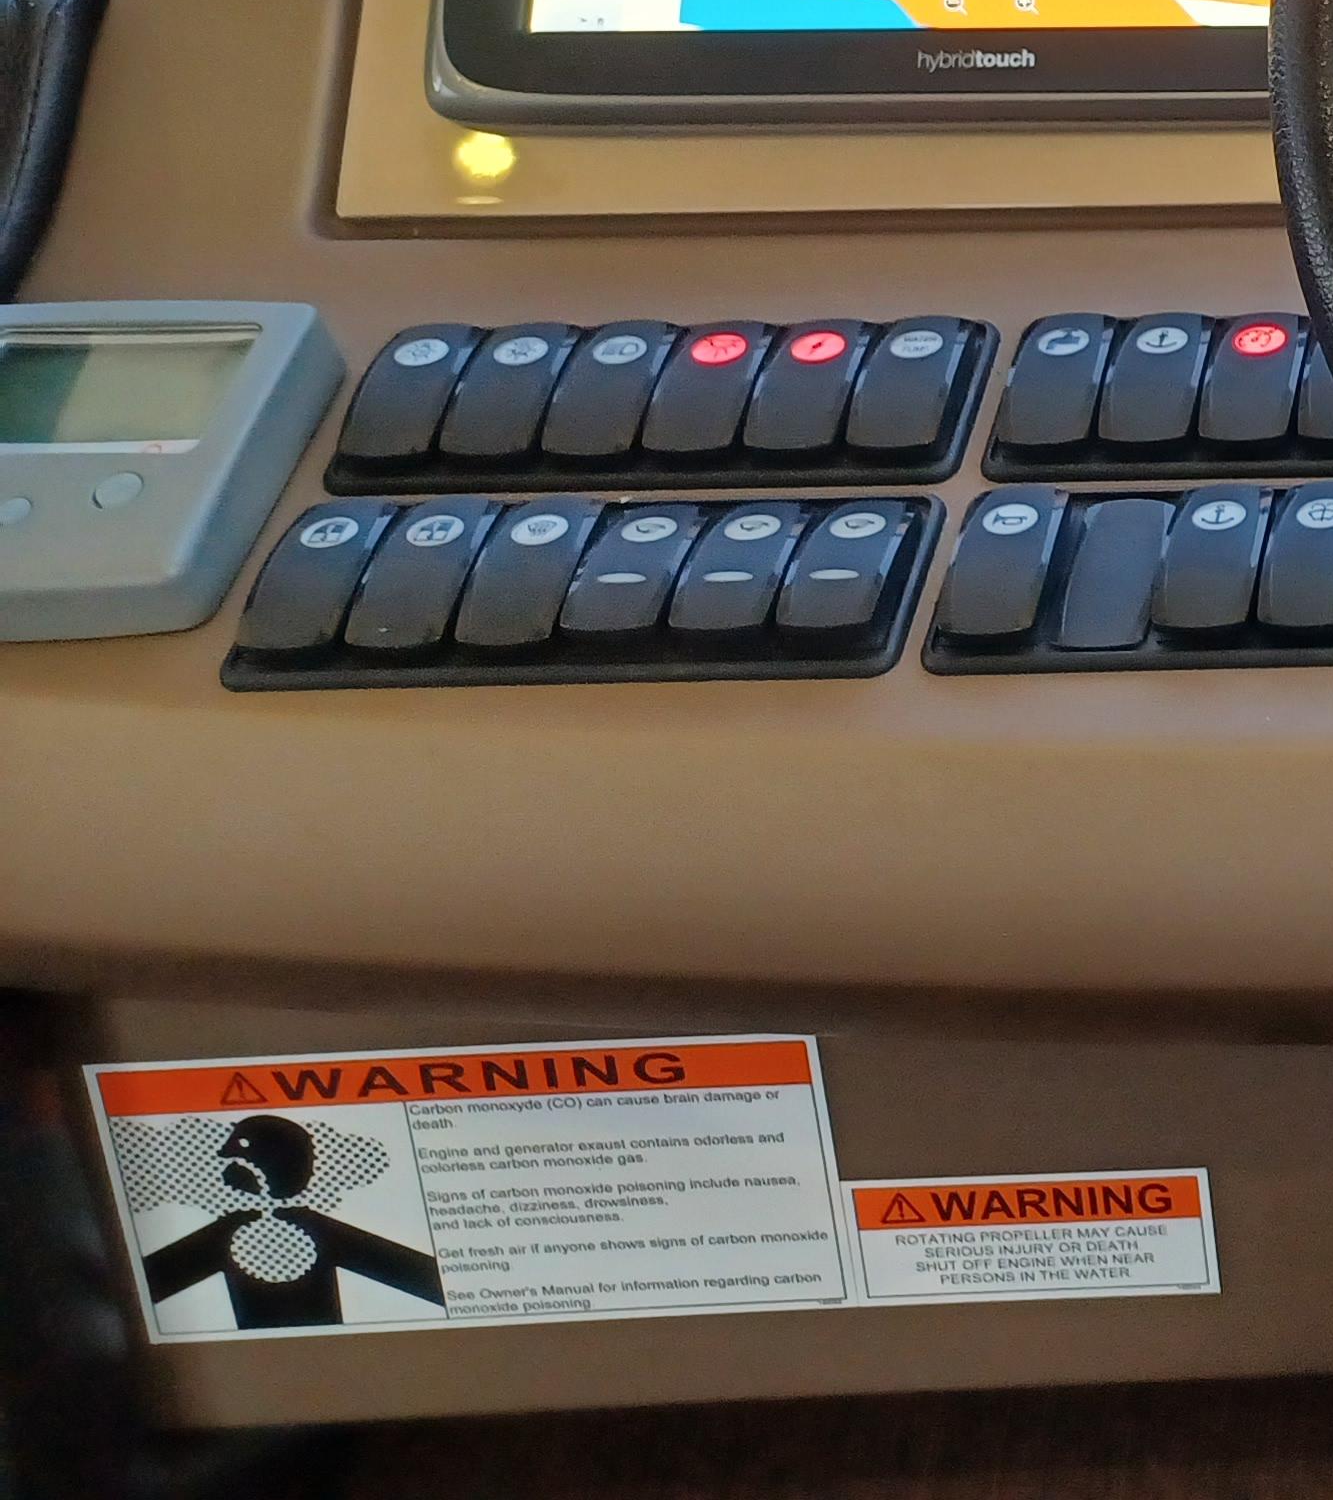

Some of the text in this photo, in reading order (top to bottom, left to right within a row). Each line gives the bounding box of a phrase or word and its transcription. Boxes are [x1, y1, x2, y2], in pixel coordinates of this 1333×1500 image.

[917, 49, 1036, 73] hybridtouch
[271, 1052, 686, 1100] WARNING
[409, 1102, 463, 1116] Carbon
[547, 1096, 583, 1112] (CO)
[586, 1096, 613, 1108] can
[616, 1095, 660, 1107] cause
[663, 1093, 700, 1105] brain
[703, 1090, 762, 1104] damage
[765, 1090, 780, 1101] or
[418, 1147, 469, 1161] Engine
[473, 1145, 500, 1158] and
[503, 1141, 574, 1159] generator
[629, 1136, 690, 1151] contains
[693, 1133, 754, 1148] odorless
[757, 1131, 785, 1145] and
[421, 1160, 486, 1175] colorless
[489, 1156, 540, 1171] carbon
[543, 1152, 614, 1169] monoxide
[426, 1190, 468, 1204] Signs
[471, 1189, 486, 1200] of
[489, 1187, 540, 1200] carbon
[543, 1182, 613, 1197] monoxide
[617, 1179, 686, 1196] poisoning
[689, 1177, 740, 1190] include
[930, 1183, 1173, 1222] WARNING
[432, 1219, 460, 1232] and
[463, 1217, 492, 1230] lack
[496, 1216, 511, 1228] of
[894, 1224, 1168, 1246] ROTATING PROPELLER MAY CAUSE
[438, 1246, 464, 1259] Get
[468, 1244, 505, 1258] fresh
[508, 1243, 526, 1256] air
[543, 1241, 596, 1256] anyone
[600, 1238, 646, 1251] shows
[649, 1236, 687, 1251] signs
[690, 1234, 704, 1247] of
[708, 1232, 757, 1246] carbon
[760, 1229, 829, 1244] monoxide
[924, 1239, 1139, 1260] SERIOUS INJURY OR DEATH
[440, 1260, 511, 1275] poisoning
[915, 1251, 1155, 1273] SHUT OFF ENGINE WHEN NEAR
[447, 1271, 822, 1302] See Owner's Manual for information regarding carbon
[940, 1266, 1131, 1285] PERSONS IN THE WATER
[449, 1299, 592, 1317] monoxide poisoning
